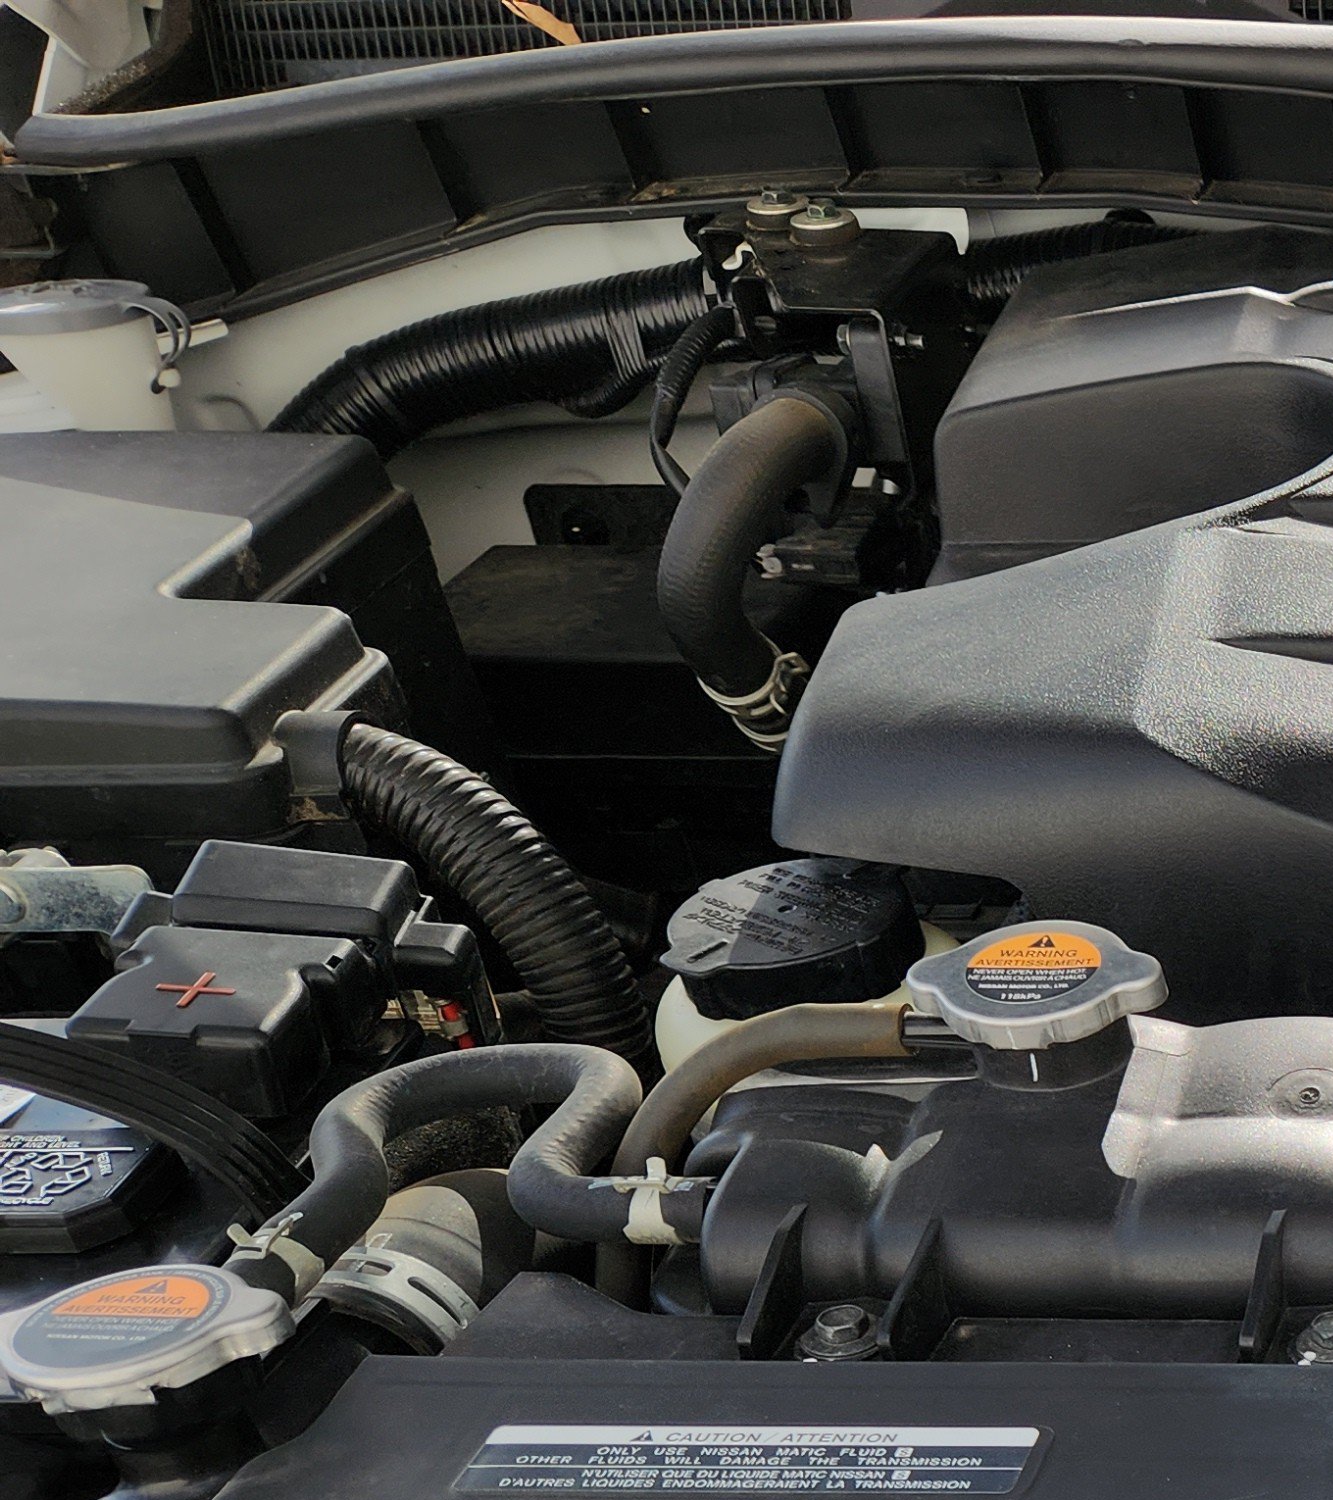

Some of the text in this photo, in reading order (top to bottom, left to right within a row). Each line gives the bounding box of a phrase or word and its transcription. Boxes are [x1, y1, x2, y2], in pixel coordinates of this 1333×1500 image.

[999, 949, 1078, 958] WARNING
[975, 957, 1095, 966] AVERTISSEMENT
[97, 1294, 186, 1304] WARNING
[63, 1304, 198, 1316] AVERTISSEMENT
[665, 1432, 763, 1443] CAUTION
[780, 1432, 899, 1444] ATTENTION
[596, 1446, 641, 1456] ONLY
[653, 1446, 688, 1456] USE
[700, 1446, 763, 1456] NISSAN
[775, 1447, 827, 1457] MATIC
[839, 1447, 887, 1457] FLUID
[515, 1455, 983, 1466] OTHER FLUIDS WILL DAMAGE THE TRANSMISSION
[581, 1469, 660, 1479] N'UTILISER
[661, 1469, 695, 1479] QUE
[696, 1469, 720, 1479] DU
[720, 1470, 781, 1480] LIQUIDE
[782, 1470, 828, 1480] MATIC
[829, 1470, 886, 1480] NISSAN
[498, 1478, 972, 1489] D'AUTRES LIQUIDES ENDOMMAGERAIENT LA TRANSMISSION
